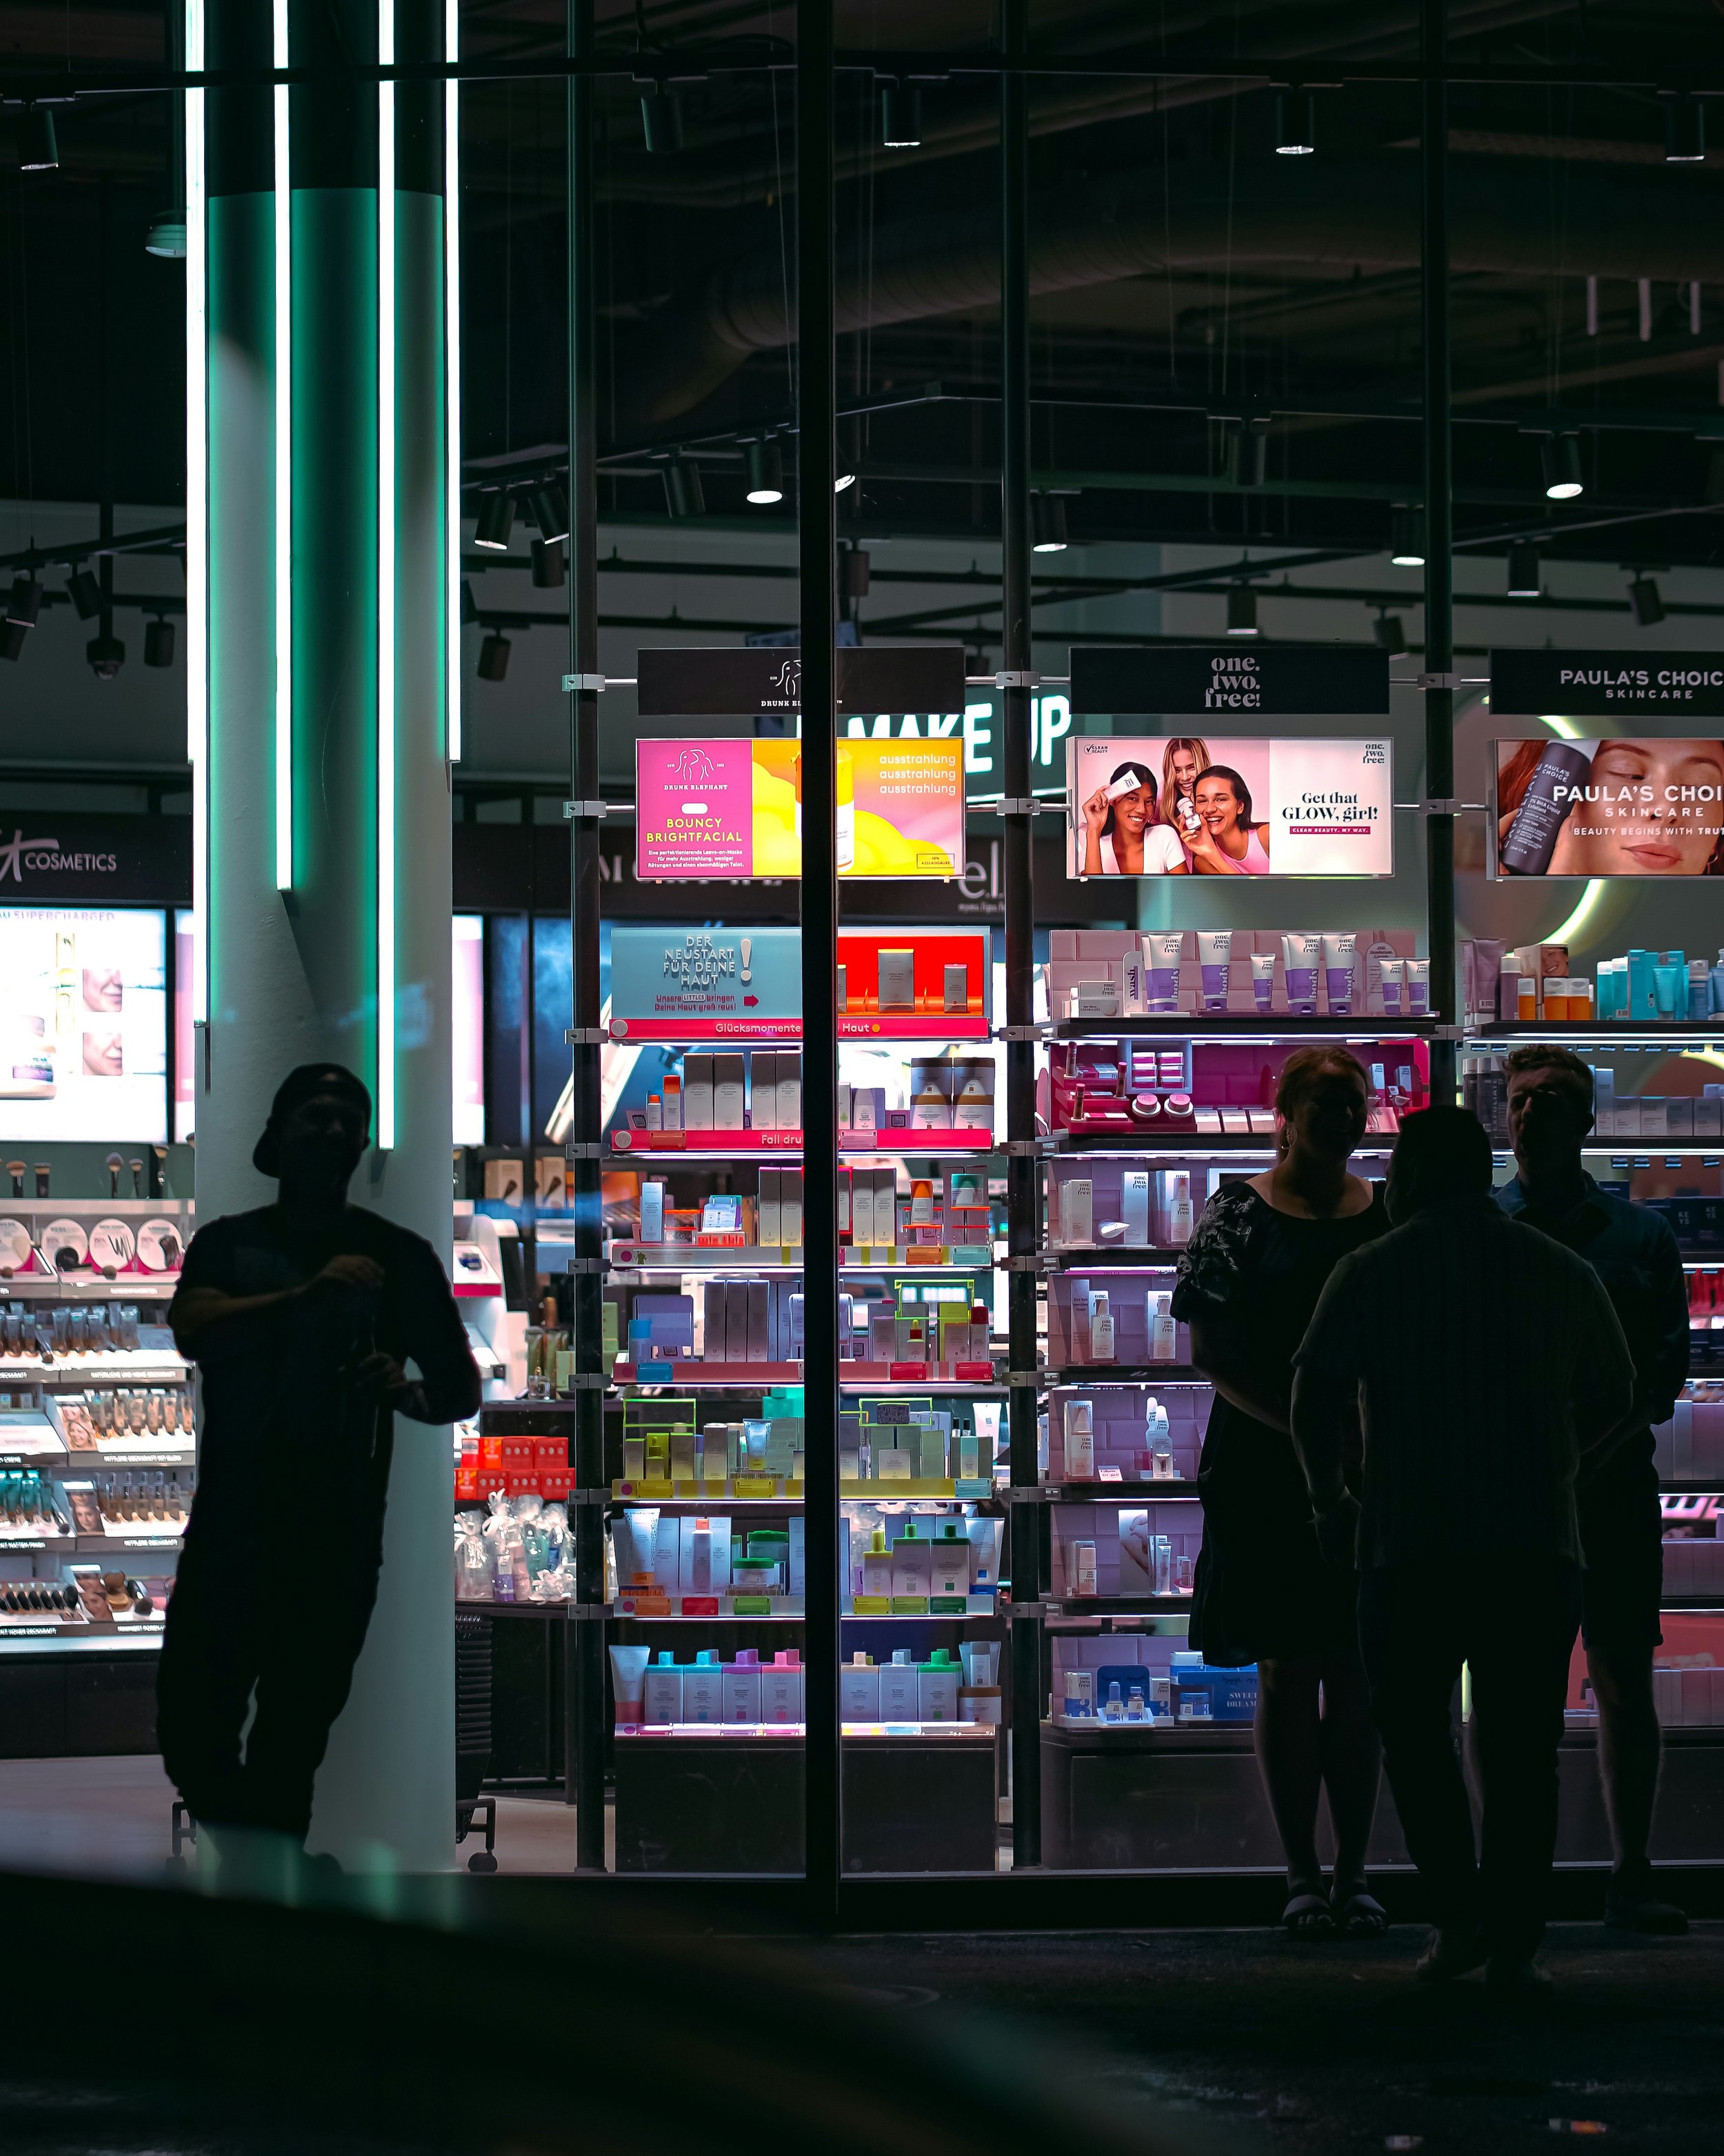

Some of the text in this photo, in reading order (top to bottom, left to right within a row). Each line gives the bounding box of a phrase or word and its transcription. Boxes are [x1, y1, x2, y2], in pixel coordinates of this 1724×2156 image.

[1211, 657, 1261, 672] one.
[1212, 672, 1261, 690] two.
[1560, 670, 1650, 686] PAULA'S
[1204, 688, 1261, 708] free!
[1605, 690, 1694, 699] SKINCARE
[879, 754, 956, 766] ausstrahlung
[879, 768, 956, 781] ausstrahlung
[1541, 769, 1568, 783] CHOICE
[879, 783, 956, 796] ausstrahlung
[1553, 786, 1722, 803] PAULA'S CHOI
[1302, 792, 1358, 803] Get that
[1536, 800, 1547, 808] BHA
[1282, 806, 1379, 823] GLOW, girl!
[1605, 807, 1705, 817] SKINCARE
[666, 818, 723, 828] BOUNCY
[646, 832, 743, 843] BRIGHTFACIAL
[1573, 828, 1617, 836] BEAUTY
[1621, 828, 1661, 837] BEGINS
[1666, 828, 1694, 836] WITH
[25, 852, 117, 872] COSMETICS
[686, 936, 713, 947] DER
[664, 949, 734, 960] NEUSTART
[663, 960, 736, 972] FÜR DEINE
[681, 975, 719, 986] HAUT
[706, 994, 735, 1004] bringen
[715, 1023, 870, 1033] Glücksmomente Haut
